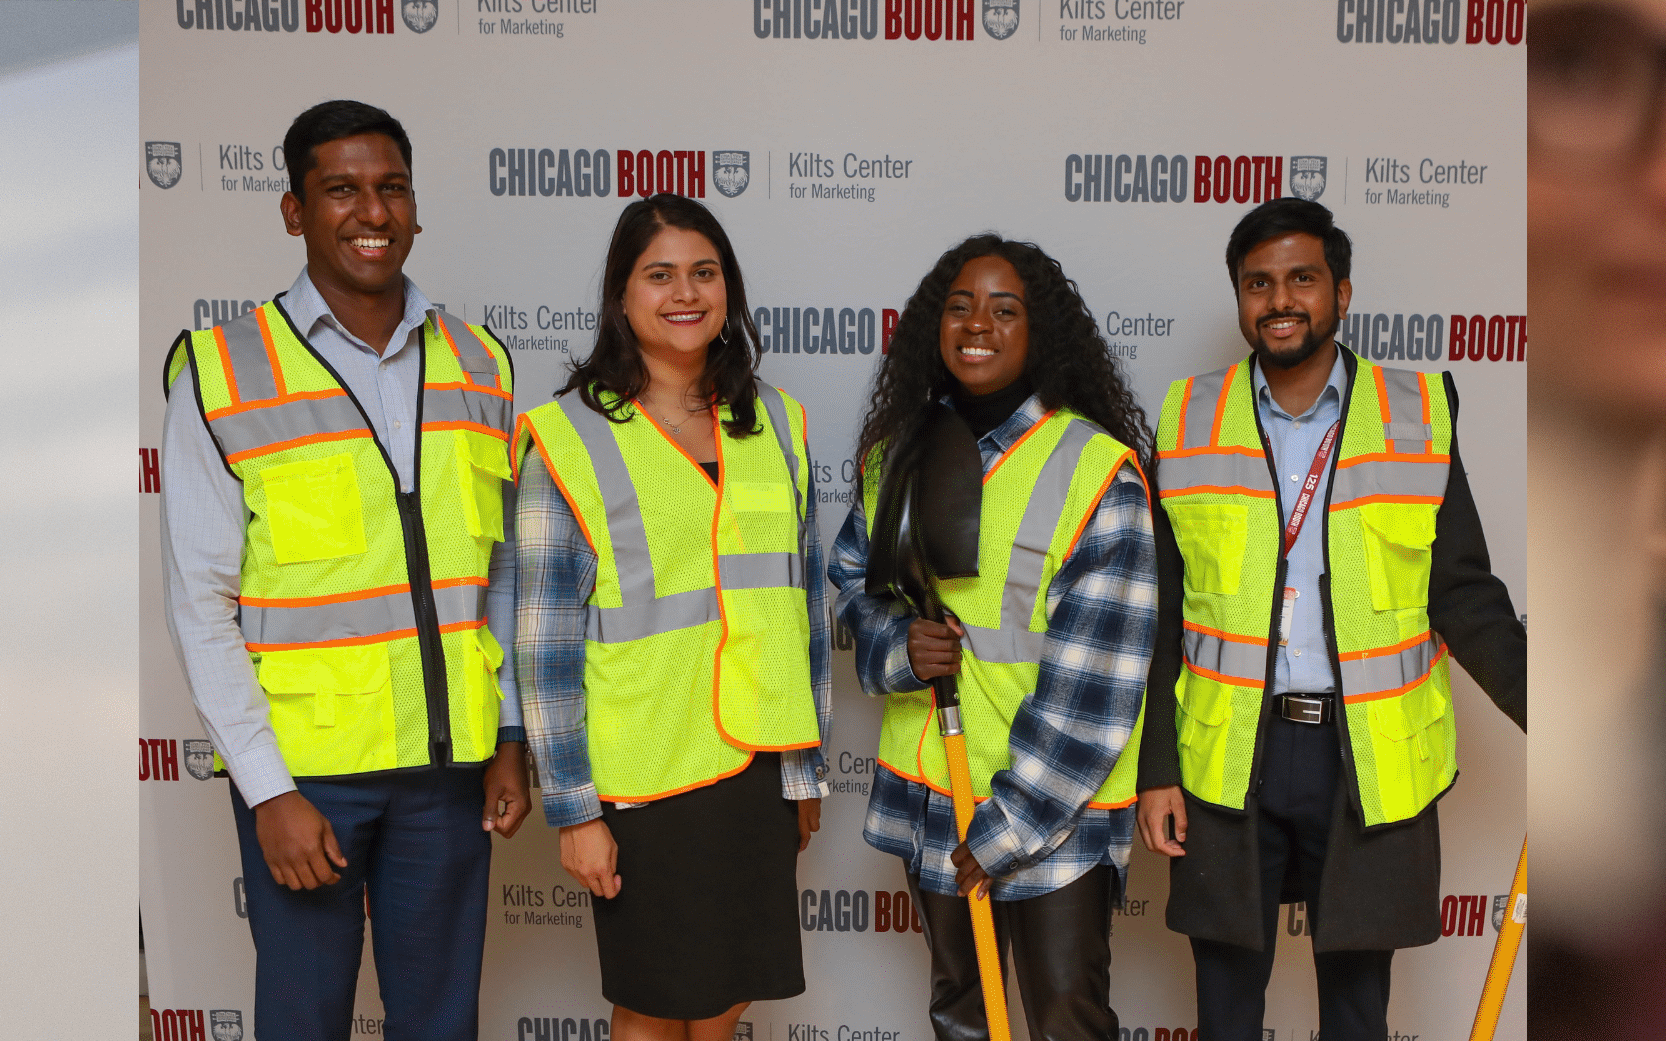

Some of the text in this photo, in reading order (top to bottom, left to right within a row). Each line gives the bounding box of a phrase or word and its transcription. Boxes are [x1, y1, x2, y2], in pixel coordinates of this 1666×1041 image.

[176, 0, 299, 32] CHICAGO
[754, 0, 975, 41] CHICAGO BOOTH
[1060, 0, 1185, 20] Kilts Center
[1337, 0, 1527, 45] CHICAGO BOO
[478, 18, 564, 38] for Marketing
[1060, 25, 1147, 45] for Marketing
[219, 144, 264, 171] Kilts
[789, 152, 913, 179] Kilts Center
[489, 147, 706, 198] CHICAGO BOOTH
[1064, 154, 1283, 204] CHICAGO BOOTH
[1365, 157, 1488, 184] Kilts Center
[221, 175, 290, 193] for Marketi
[789, 183, 876, 203] for Marketing
[1365, 188, 1450, 208] for Marketing
[484, 305, 597, 330] Kilts Cente
[1106, 311, 1175, 337] Center
[753, 306, 876, 355] CHICAGO
[1337, 313, 1444, 361] HICAGO
[506, 335, 569, 354] Marketing
[1107, 342, 1137, 360] eting
[1304, 474, 1318, 491] 125
[139, 738, 180, 781] OTH
[839, 751, 876, 774] Cen
[828, 779, 869, 796] rketing
[502, 884, 589, 907] Kilts Cen
[504, 911, 582, 929] for Marketing
[800, 889, 869, 932] CAGO
[1441, 894, 1487, 937] OTH
[788, 1024, 900, 1041] Kilts Center
